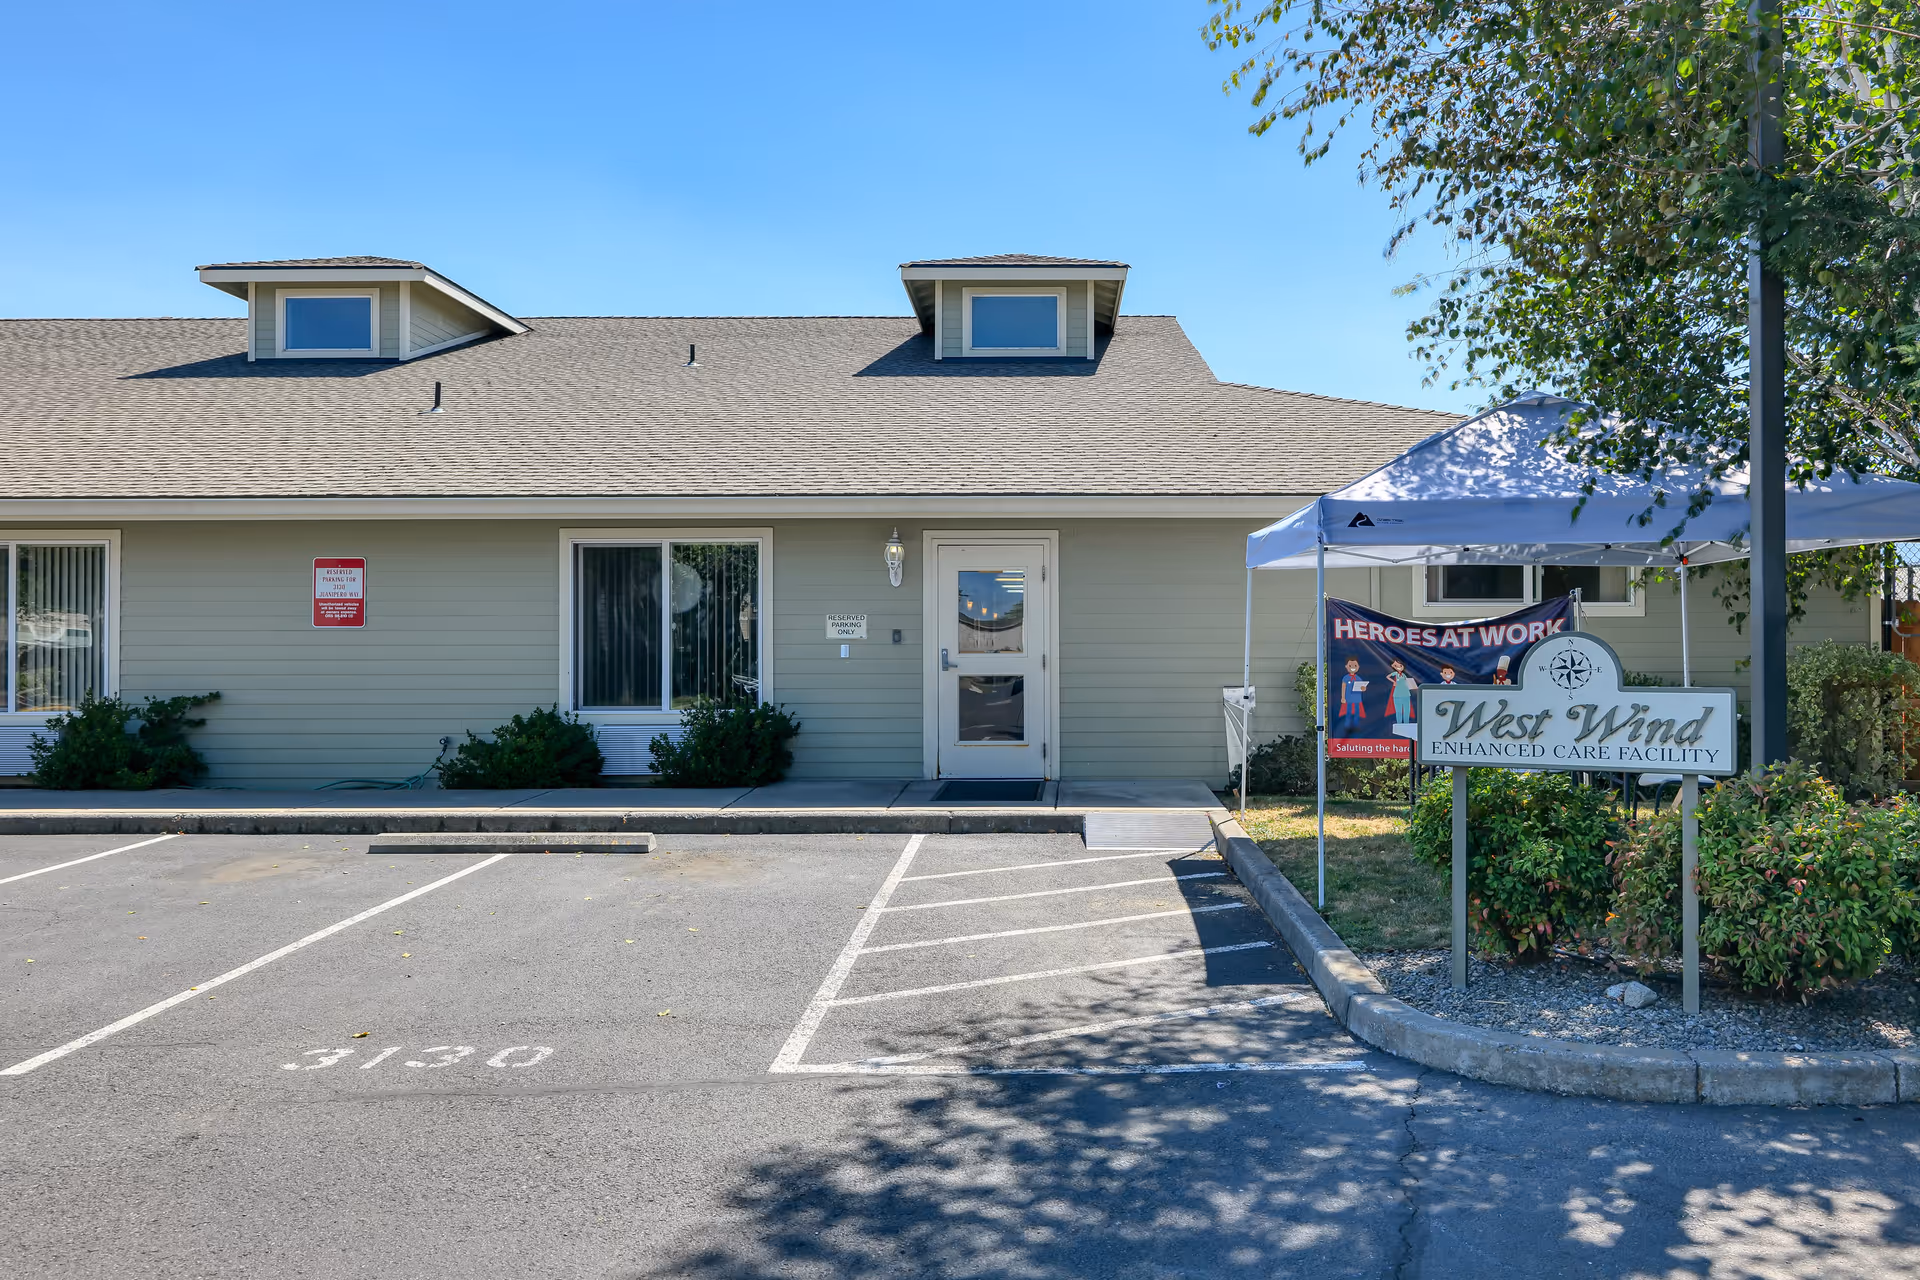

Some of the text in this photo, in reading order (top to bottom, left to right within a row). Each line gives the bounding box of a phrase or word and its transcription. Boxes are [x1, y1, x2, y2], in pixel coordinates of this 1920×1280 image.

[1334, 618, 1566, 648] HEROES AT WORK
[1435, 699, 1714, 744] West Wind
[1336, 744, 1373, 753] Saluting
[1432, 742, 1720, 763] ENHANCED CARE FACILITY
[280, 1046, 553, 1070] 3130
